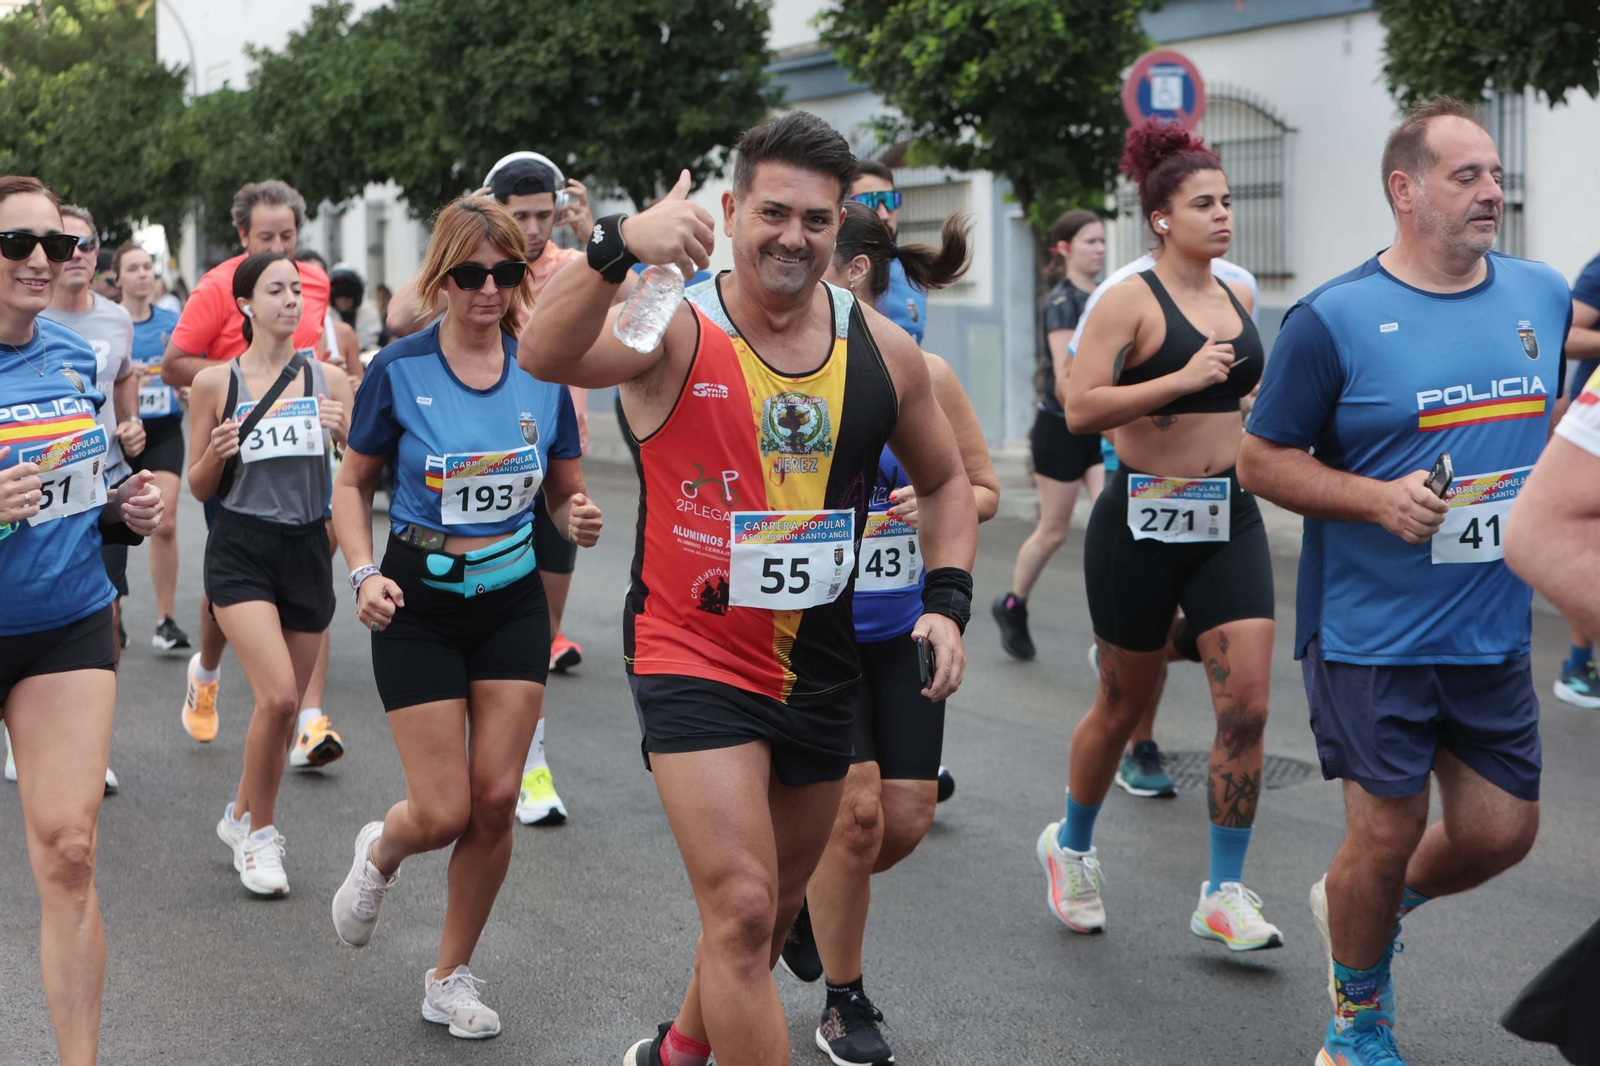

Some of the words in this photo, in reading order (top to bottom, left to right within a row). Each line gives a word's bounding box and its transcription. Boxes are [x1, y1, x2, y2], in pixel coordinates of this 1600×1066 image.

[66, 435, 101, 453] POPULAR
[249, 425, 299, 450] 314
[67, 451, 87, 463] SANTO
[87, 444, 105, 455] ANGEL
[452, 460, 495, 469] CARRERA
[497, 454, 534, 466] POPULAR
[520, 462, 538, 470] ANGEL
[774, 457, 818, 473] JEREZ
[1449, 483, 1489, 496] ARRERA
[1492, 476, 1526, 490] POPULA
[1491, 489, 1515, 499] SANTO
[455, 484, 514, 512] 193
[743, 521, 799, 531] CARRERA
[802, 518, 846, 530] POPULAR
[1140, 507, 1194, 532] 271
[672, 524, 724, 547] ALUMINIOS
[741, 533, 798, 541] ASOCIACION
[800, 532, 827, 540] SANTO
[828, 530, 850, 539] ANGEL
[883, 527, 902, 535] SANTO
[1458, 514, 1500, 549] 41
[760, 557, 810, 594] 55
